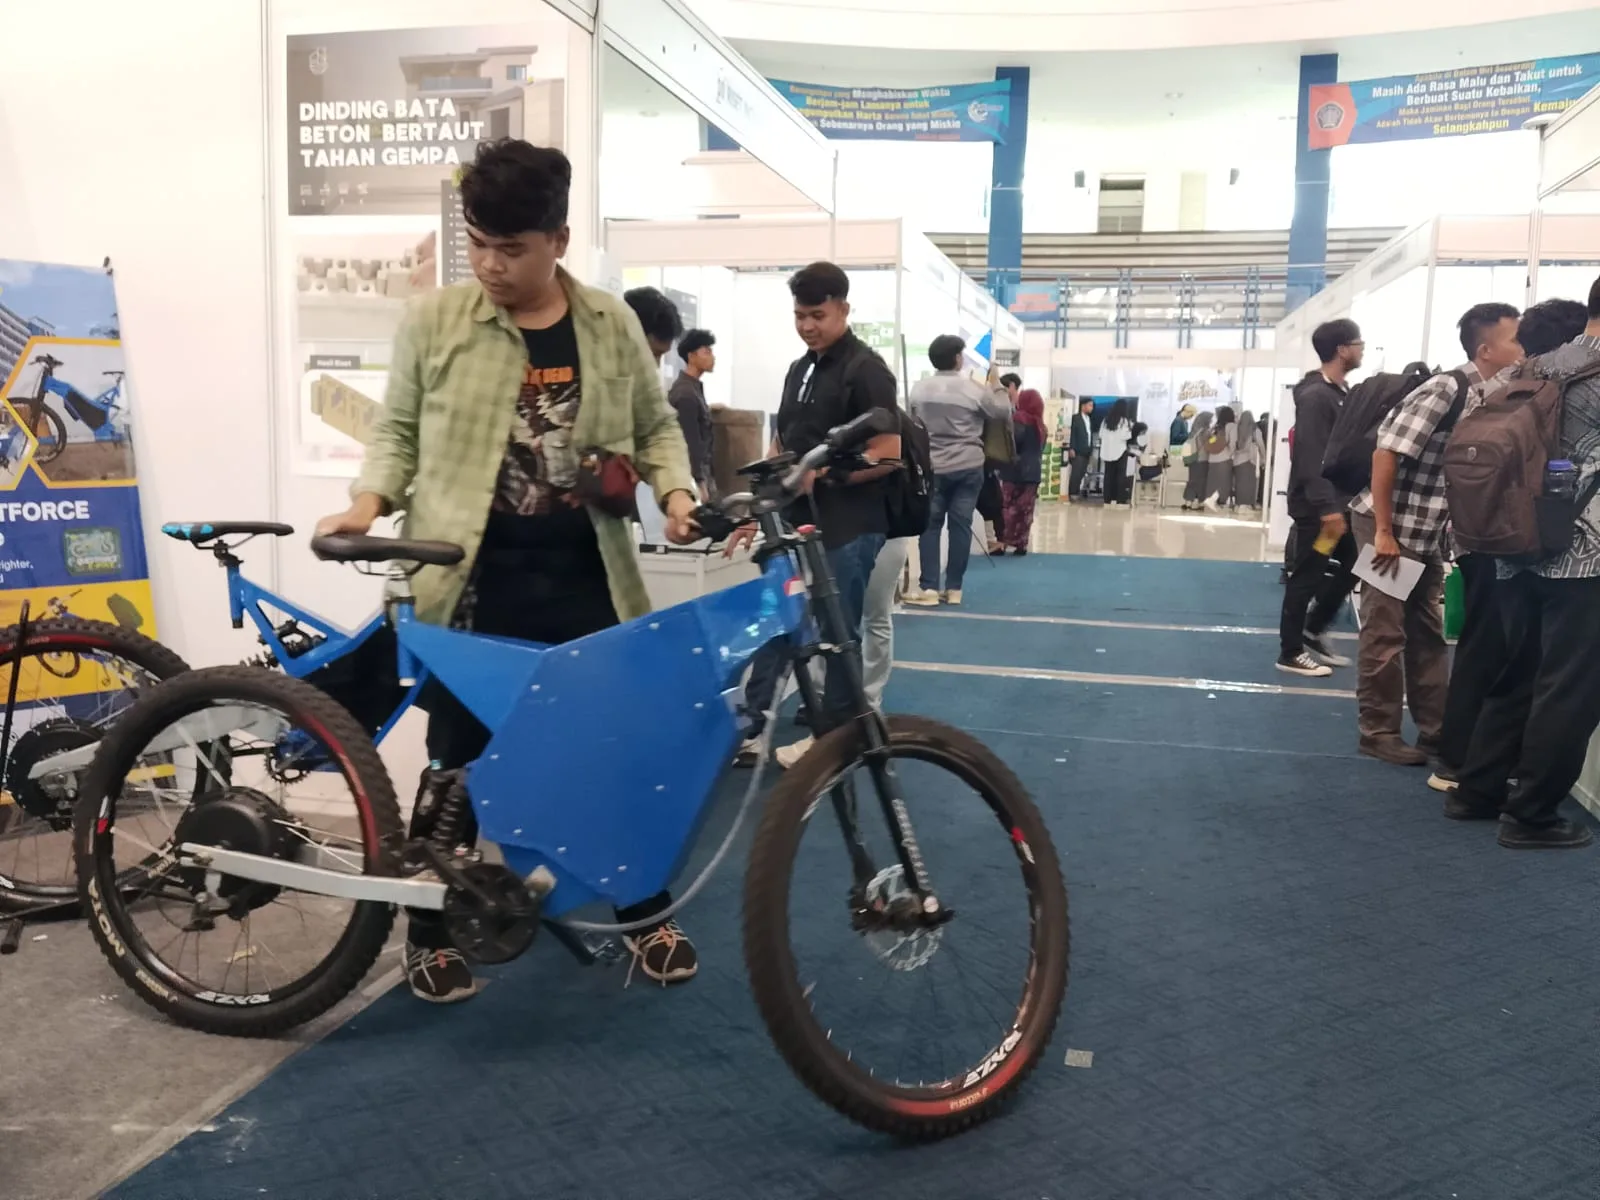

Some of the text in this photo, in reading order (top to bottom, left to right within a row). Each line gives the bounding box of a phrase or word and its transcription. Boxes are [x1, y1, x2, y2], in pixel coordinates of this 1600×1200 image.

[1372, 63, 1583, 98] Masih Ada Rasa Malu dan Takut untuk
[1406, 83, 1541, 106] Berbuat Suatu Kebaikan,
[300, 97, 457, 121] DINDING BATA
[300, 121, 485, 145] BETON BERTAUT
[875, 121, 904, 132] Orang
[905, 121, 929, 132] yang
[930, 119, 961, 129] Miskin
[1433, 119, 1510, 136] Selangkahpun
[300, 147, 460, 168] TAHAN GEMPA
